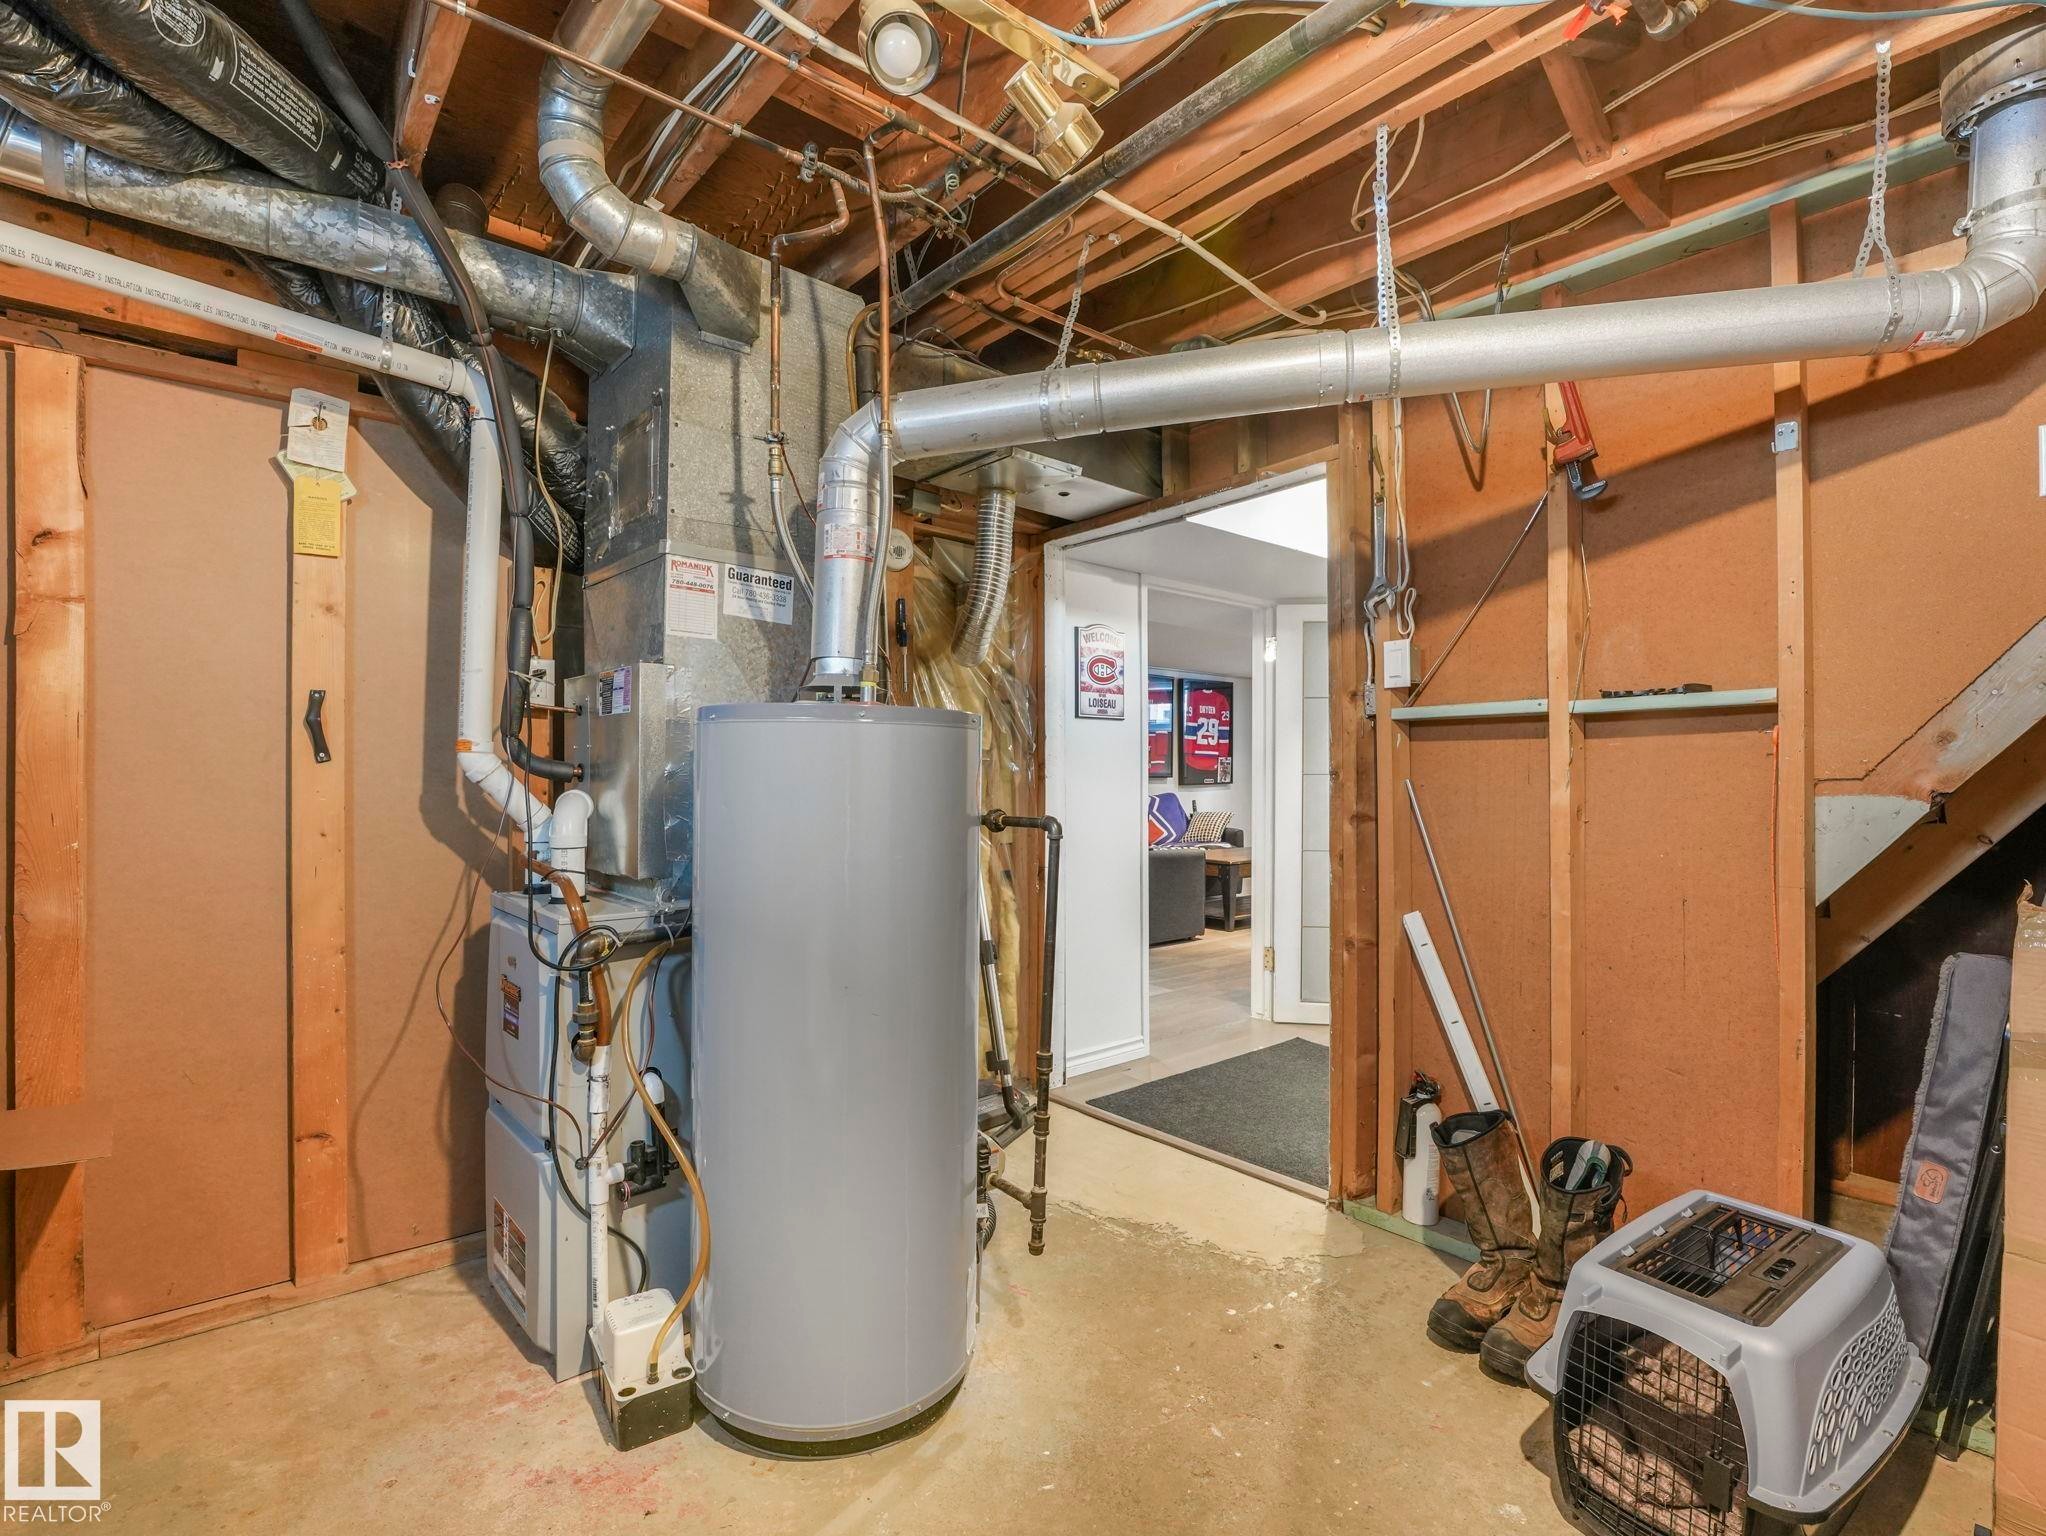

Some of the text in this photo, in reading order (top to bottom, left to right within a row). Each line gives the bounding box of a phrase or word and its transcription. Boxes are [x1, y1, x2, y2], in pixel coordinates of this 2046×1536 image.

[31, 254, 52, 266] FOLLOW
[105, 276, 143, 292] INSTALLATION
[203, 305, 213, 313] LES
[216, 309, 249, 324] INSTRUCTIONS
[671, 560, 714, 578] ROMANIUK
[728, 568, 792, 591] Guaranteed
[1083, 632, 1121, 648] WELCOME
[1088, 698, 1116, 709] LOISEAU
[1197, 717, 1219, 745] 29
